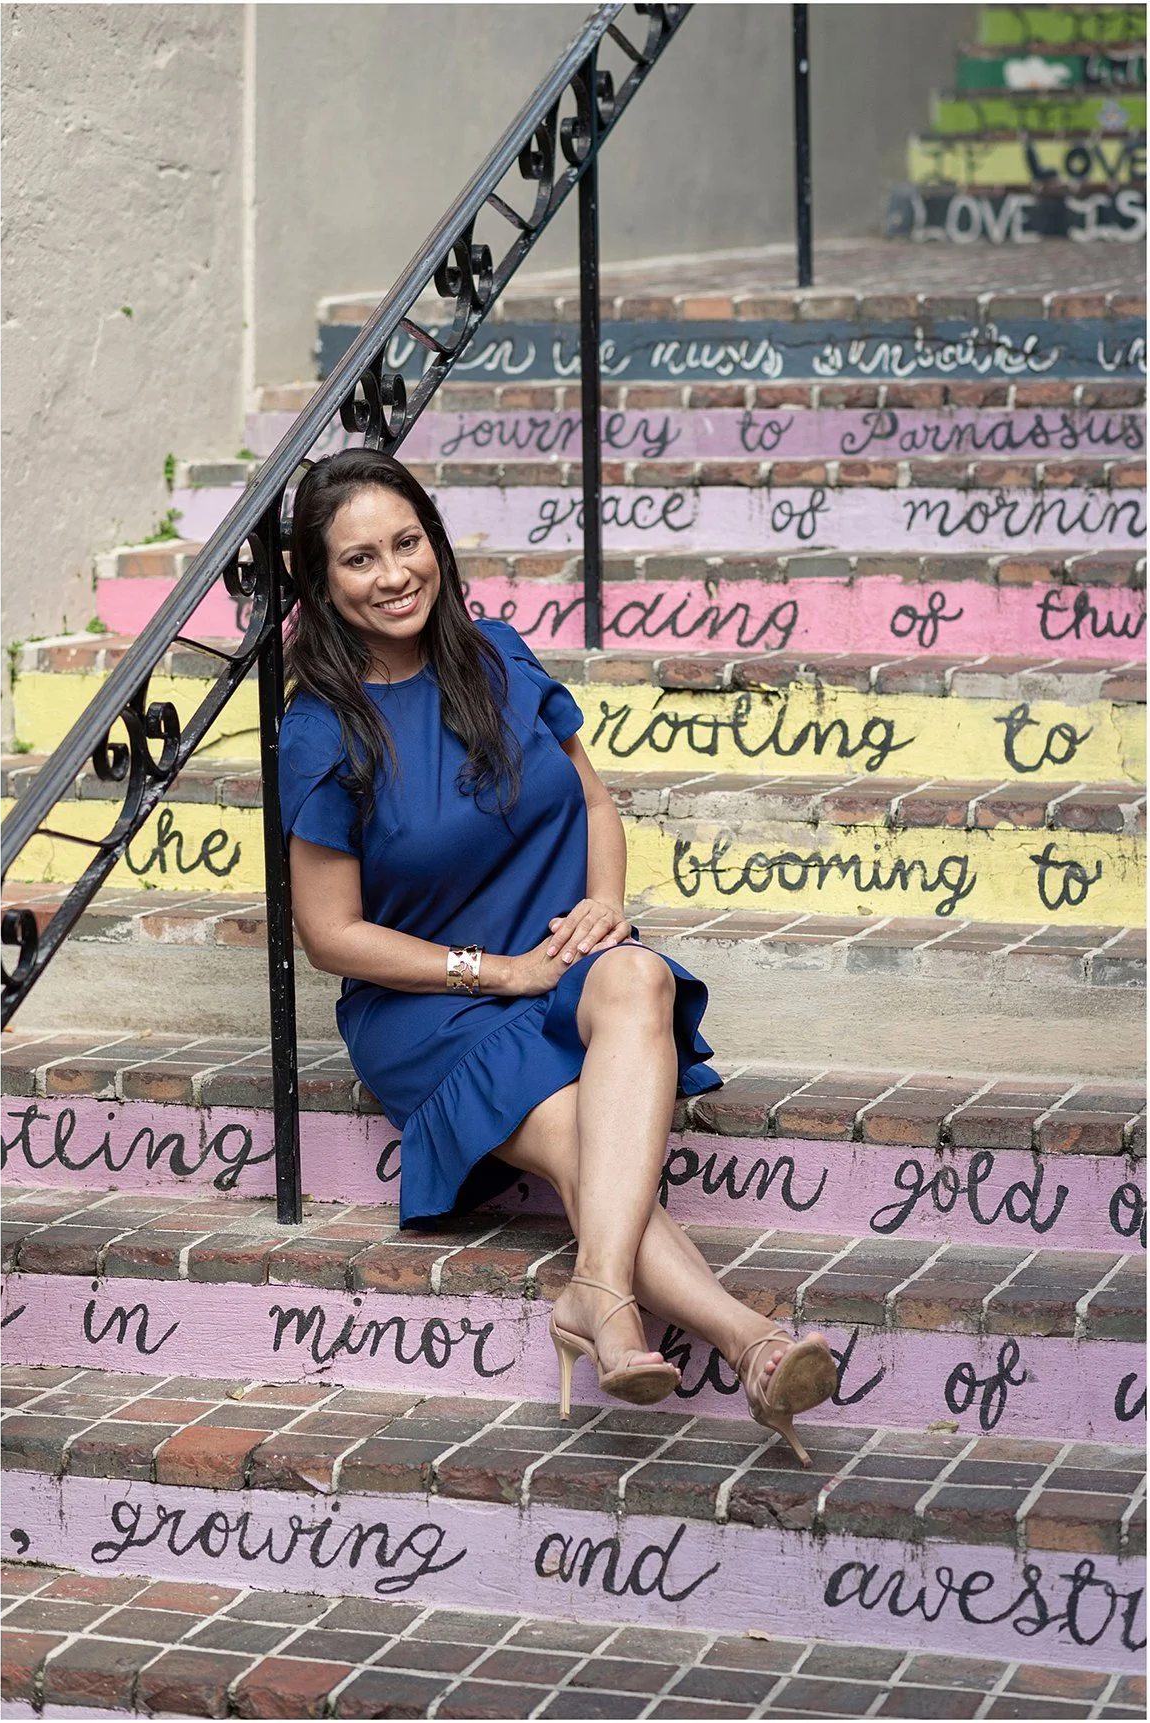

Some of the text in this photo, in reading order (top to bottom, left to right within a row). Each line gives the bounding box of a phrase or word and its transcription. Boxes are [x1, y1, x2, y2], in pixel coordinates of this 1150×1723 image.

[1023, 141, 1146, 182] LOVE
[910, 191, 1146, 244] LOVE IS
[439, 411, 1144, 458] journey to Parnassus
[528, 488, 1146, 545] grace of mornin
[891, 591, 963, 648] of
[1036, 588, 1146, 641] thu
[591, 690, 1093, 773] rooting to
[673, 836, 978, 917] blooming
[1029, 844, 1102, 910] to
[657, 1146, 829, 1212] pun
[869, 1150, 1069, 1235] gold
[83, 1280, 180, 1355] in
[268, 1296, 516, 1378] minor
[944, 1337, 1028, 1430] of
[91, 1500, 1147, 1653] growing and awestr
